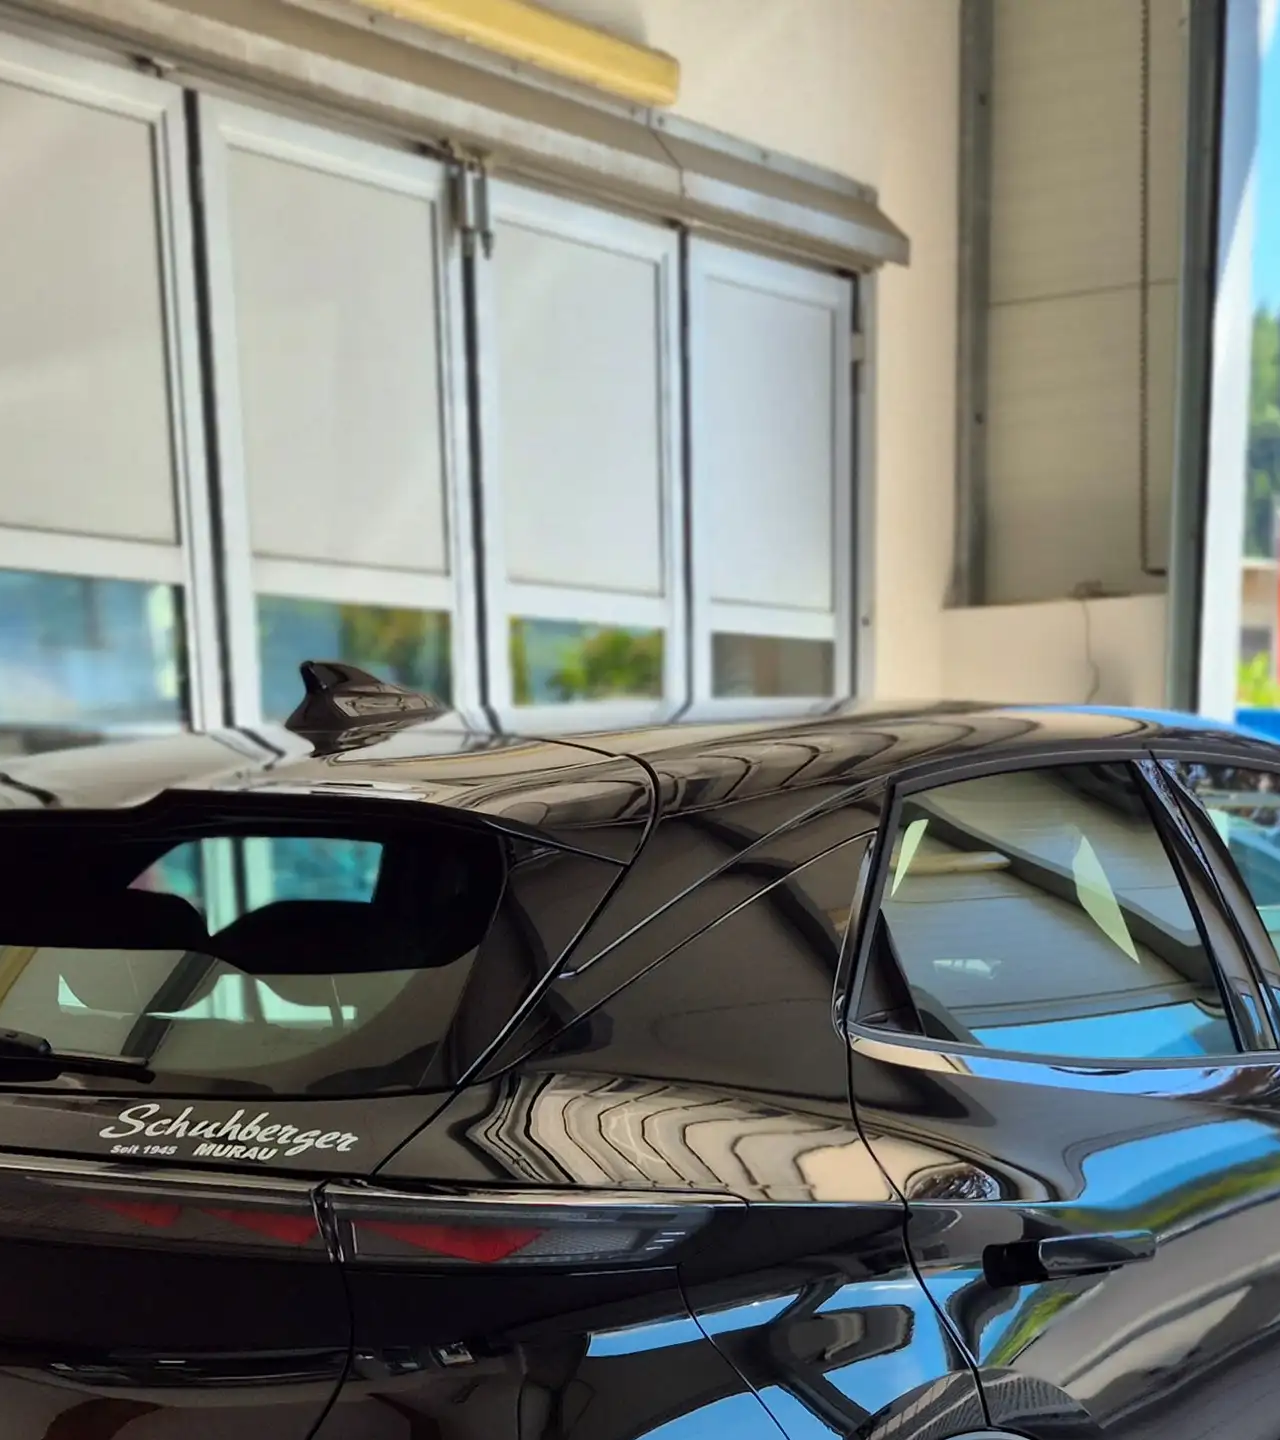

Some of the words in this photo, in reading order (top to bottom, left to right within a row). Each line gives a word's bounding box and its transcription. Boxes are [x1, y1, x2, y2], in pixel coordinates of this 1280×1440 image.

[99, 1103, 359, 1157] Schuhberger
[110, 1144, 138, 1155] Seit
[143, 1145, 178, 1156] 1945
[192, 1143, 279, 1160] MURAU
